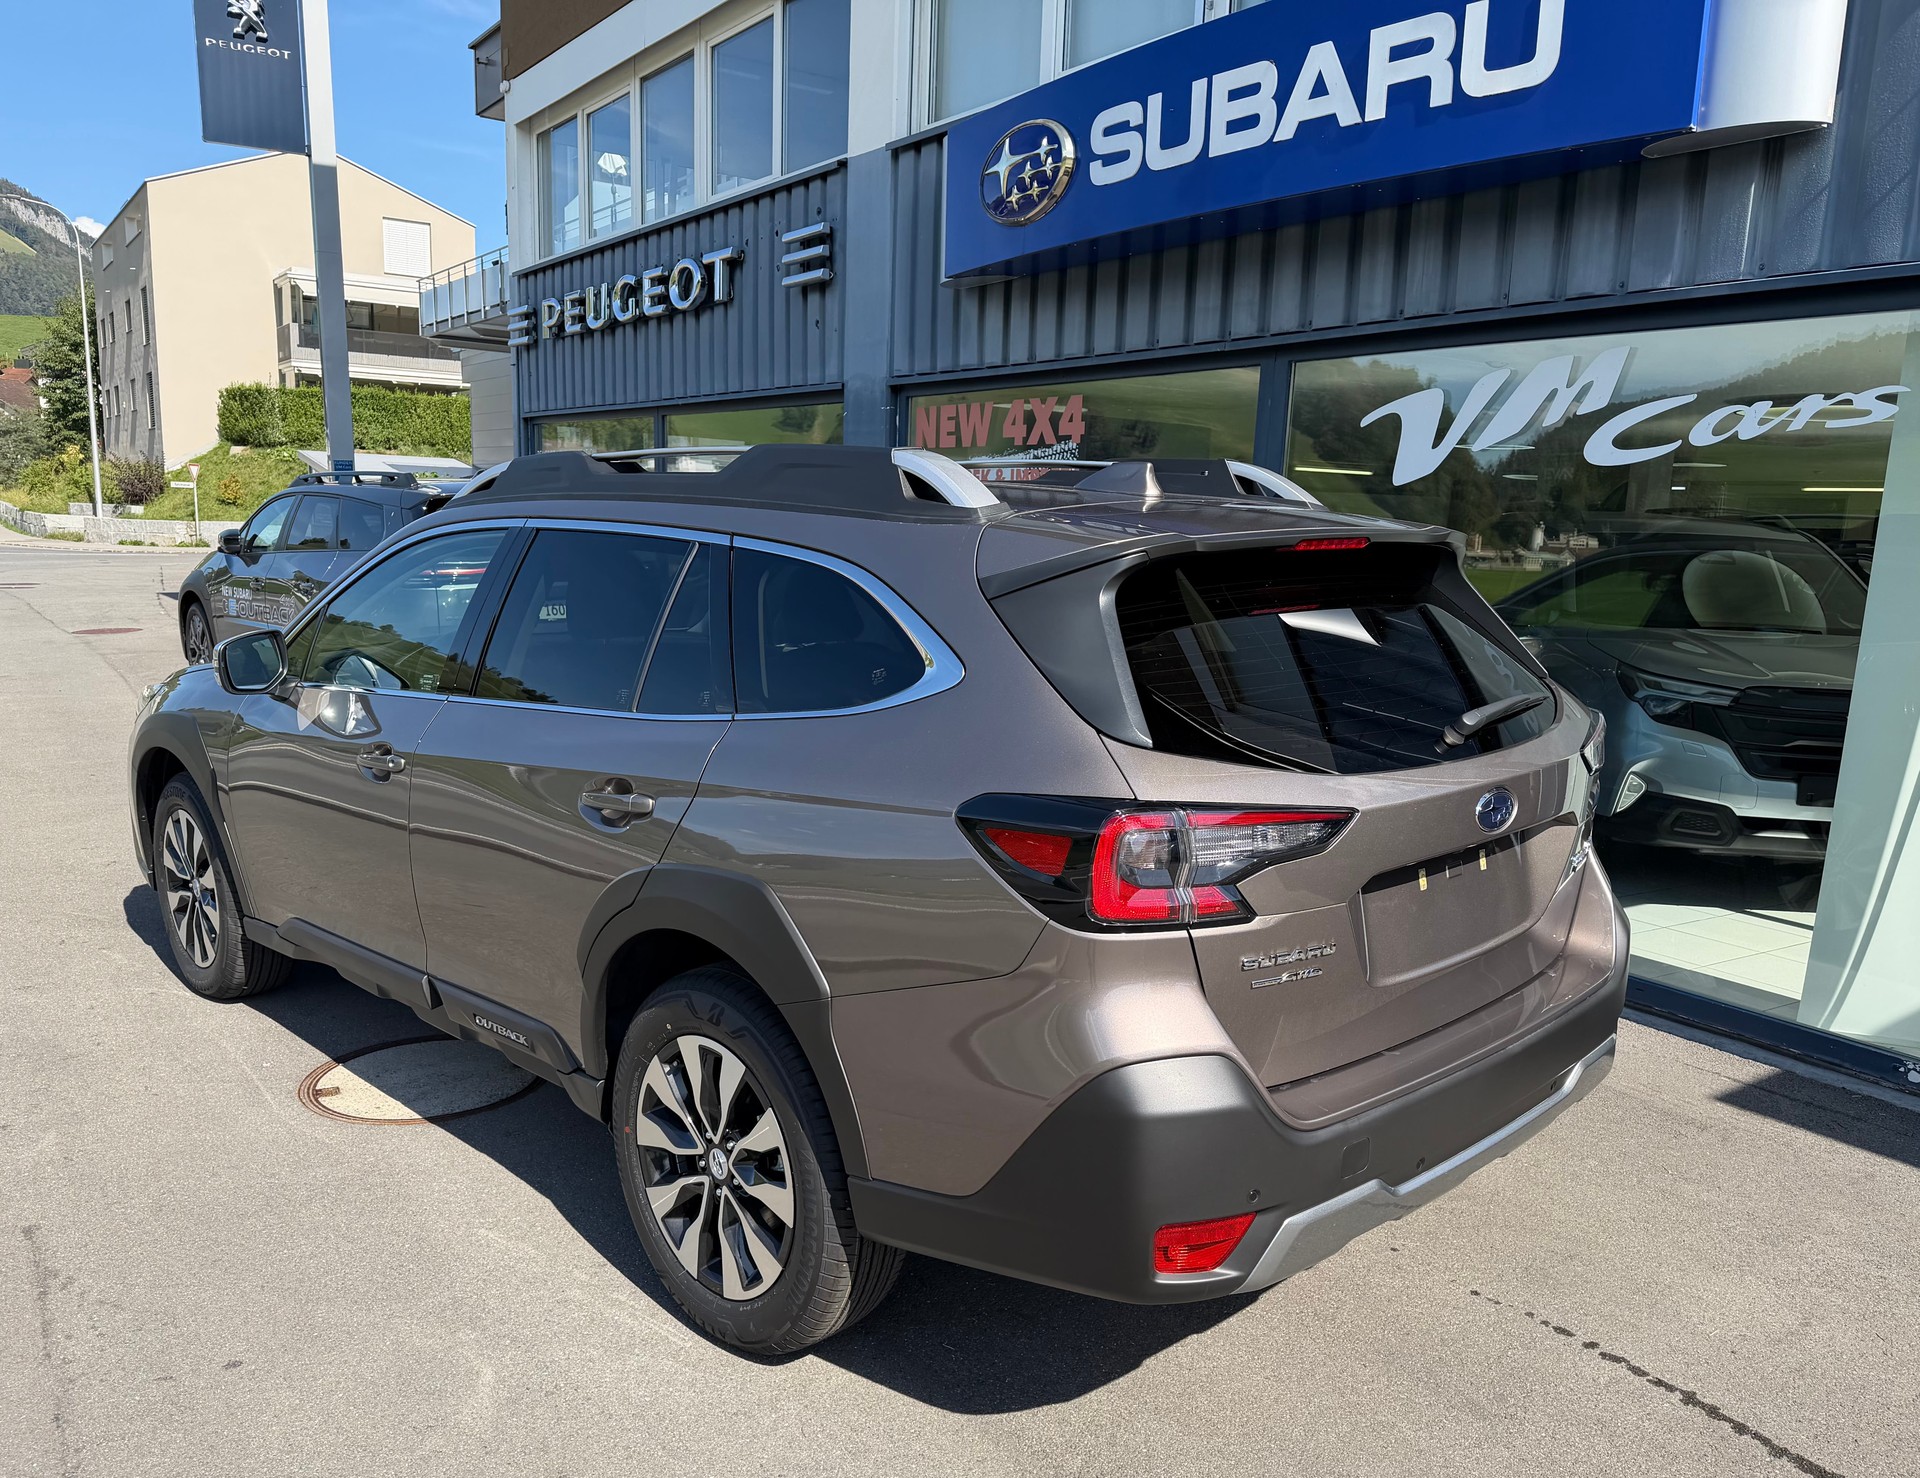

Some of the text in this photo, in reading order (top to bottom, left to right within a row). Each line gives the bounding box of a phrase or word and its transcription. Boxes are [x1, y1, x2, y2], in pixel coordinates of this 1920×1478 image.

[204, 37, 292, 60] PEUGEOT
[1089, 0, 1566, 187] SUBARU
[541, 246, 741, 339] PEUGEOT
[915, 394, 1086, 449] NEW 4X4
[1360, 345, 1912, 487] VM Cars
[221, 585, 253, 600] NEW SUBARU
[1241, 942, 1337, 972] SUBARU
[475, 1015, 529, 1047] OUTBACK
